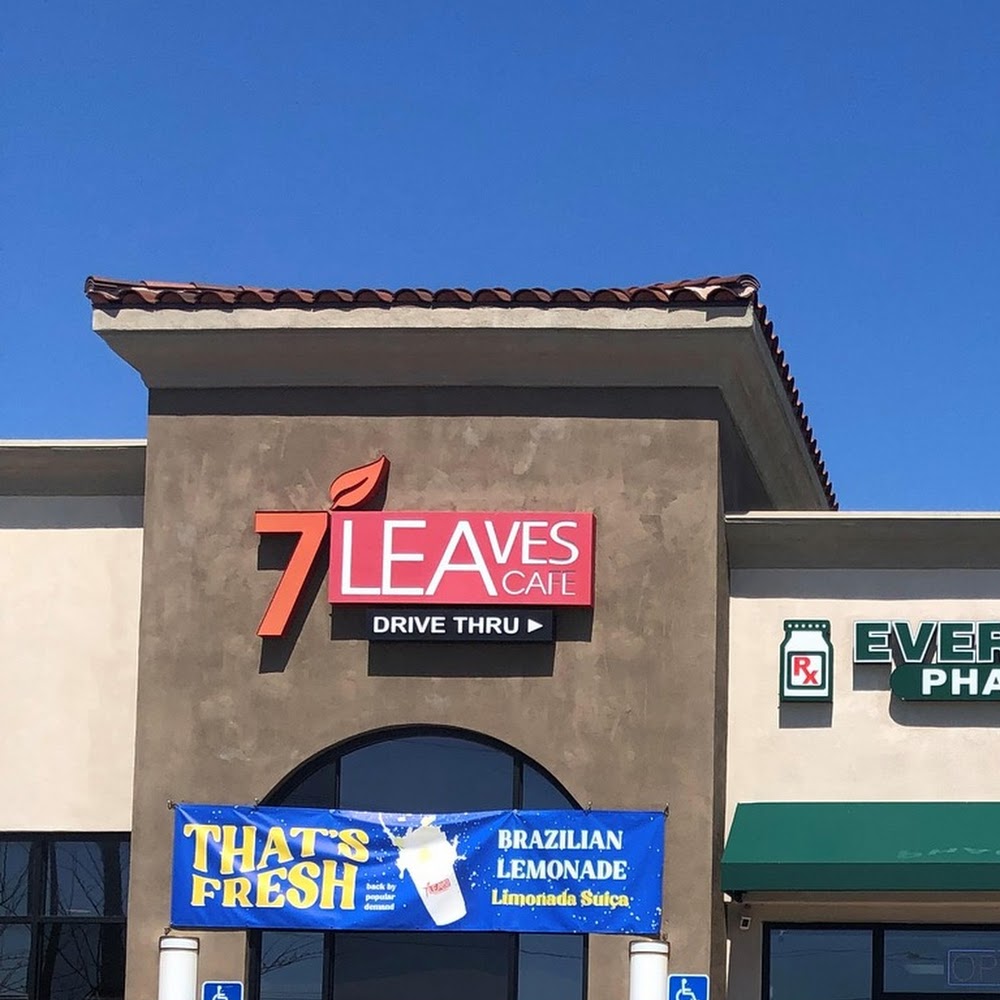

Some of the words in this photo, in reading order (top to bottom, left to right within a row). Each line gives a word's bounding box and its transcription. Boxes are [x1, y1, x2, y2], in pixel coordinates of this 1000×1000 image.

[255, 511, 331, 637] 7
[341, 519, 580, 597] LEAVES
[502, 570, 576, 596] CAFE
[373, 616, 446, 634] DRIVE
[453, 616, 519, 635] THRU
[183, 823, 371, 875] THAT'S
[498, 829, 624, 850] BRAZILIAN
[496, 859, 628, 880] LEMONADE
[191, 860, 359, 910] FRESH
[366, 882, 386, 891] back
[387, 882, 397, 893] by
[363, 902, 395, 911] demand
[365, 893, 396, 902] popular
[491, 889, 578, 906] Limonada
